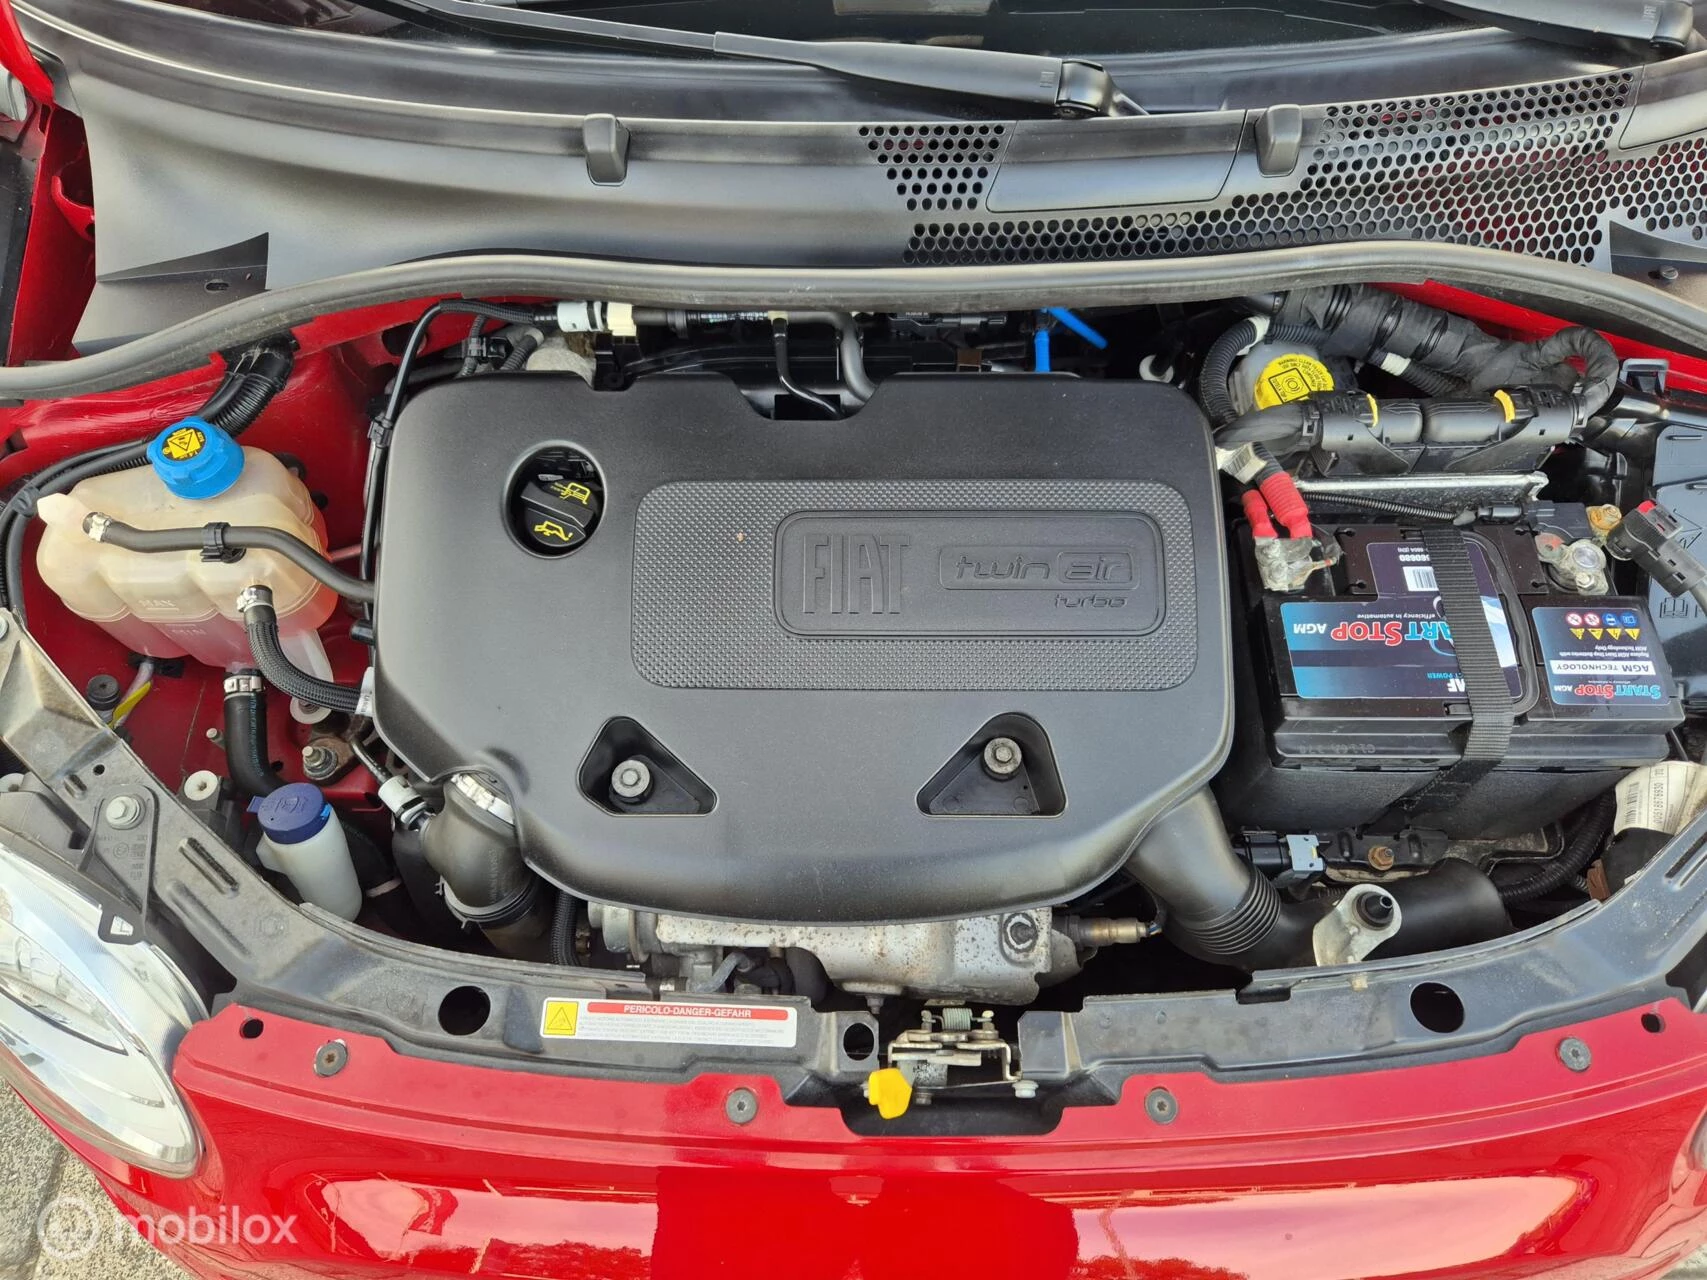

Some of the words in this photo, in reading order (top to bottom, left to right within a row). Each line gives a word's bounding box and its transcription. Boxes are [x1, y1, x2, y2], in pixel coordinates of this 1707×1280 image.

[803, 534, 910, 614] FIAT
[955, 555, 1050, 580] twin
[1065, 555, 1123, 581] air
[1054, 593, 1128, 608] turbo
[1293, 623, 1327, 634] AGM
[1331, 621, 1403, 647] STOP
[1405, 621, 1453, 641] ART
[1557, 663, 1619, 671] TECHNOLOGY
[1622, 664, 1649, 672] AGM
[624, 1004, 752, 1018] PERICOLO-DANGER-GEFAHR
